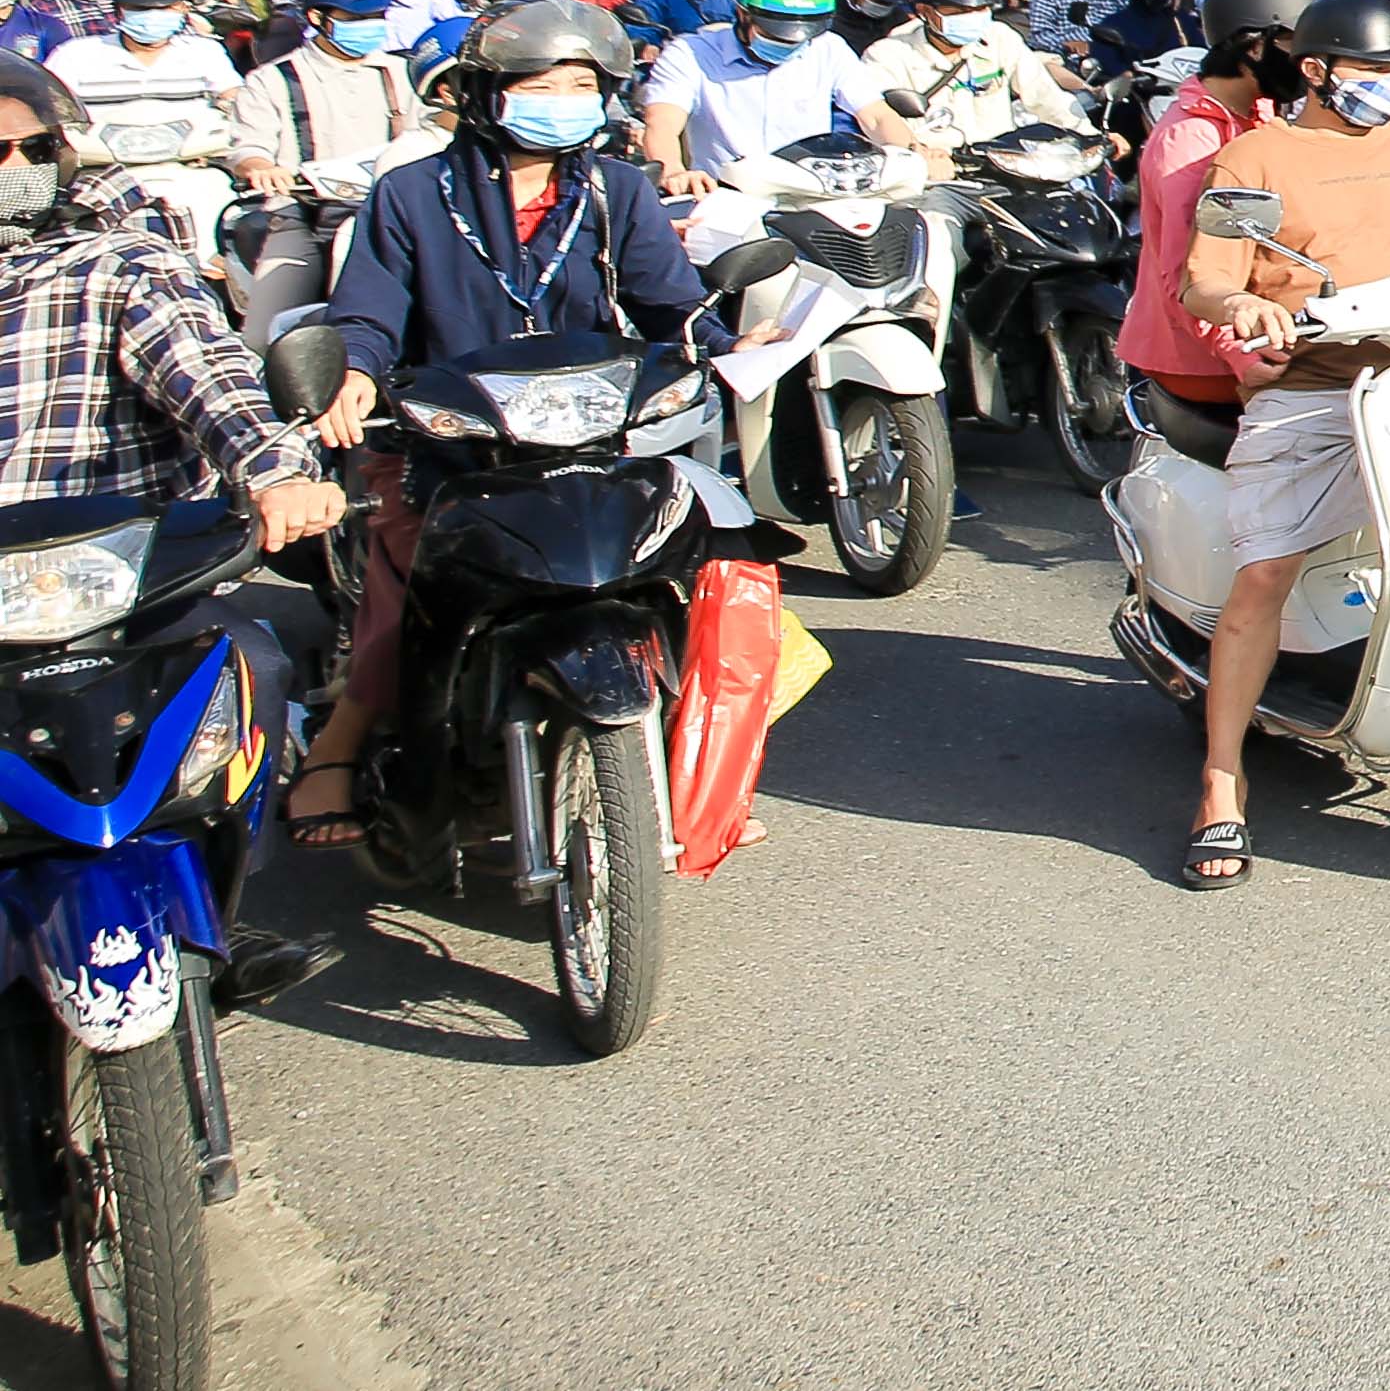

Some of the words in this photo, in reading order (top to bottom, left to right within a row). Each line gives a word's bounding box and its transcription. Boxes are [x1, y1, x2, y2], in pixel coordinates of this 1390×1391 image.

[542, 464, 608, 479] HONDA
[21, 656, 115, 681] HONDA
[1201, 823, 1238, 843] NIKE
